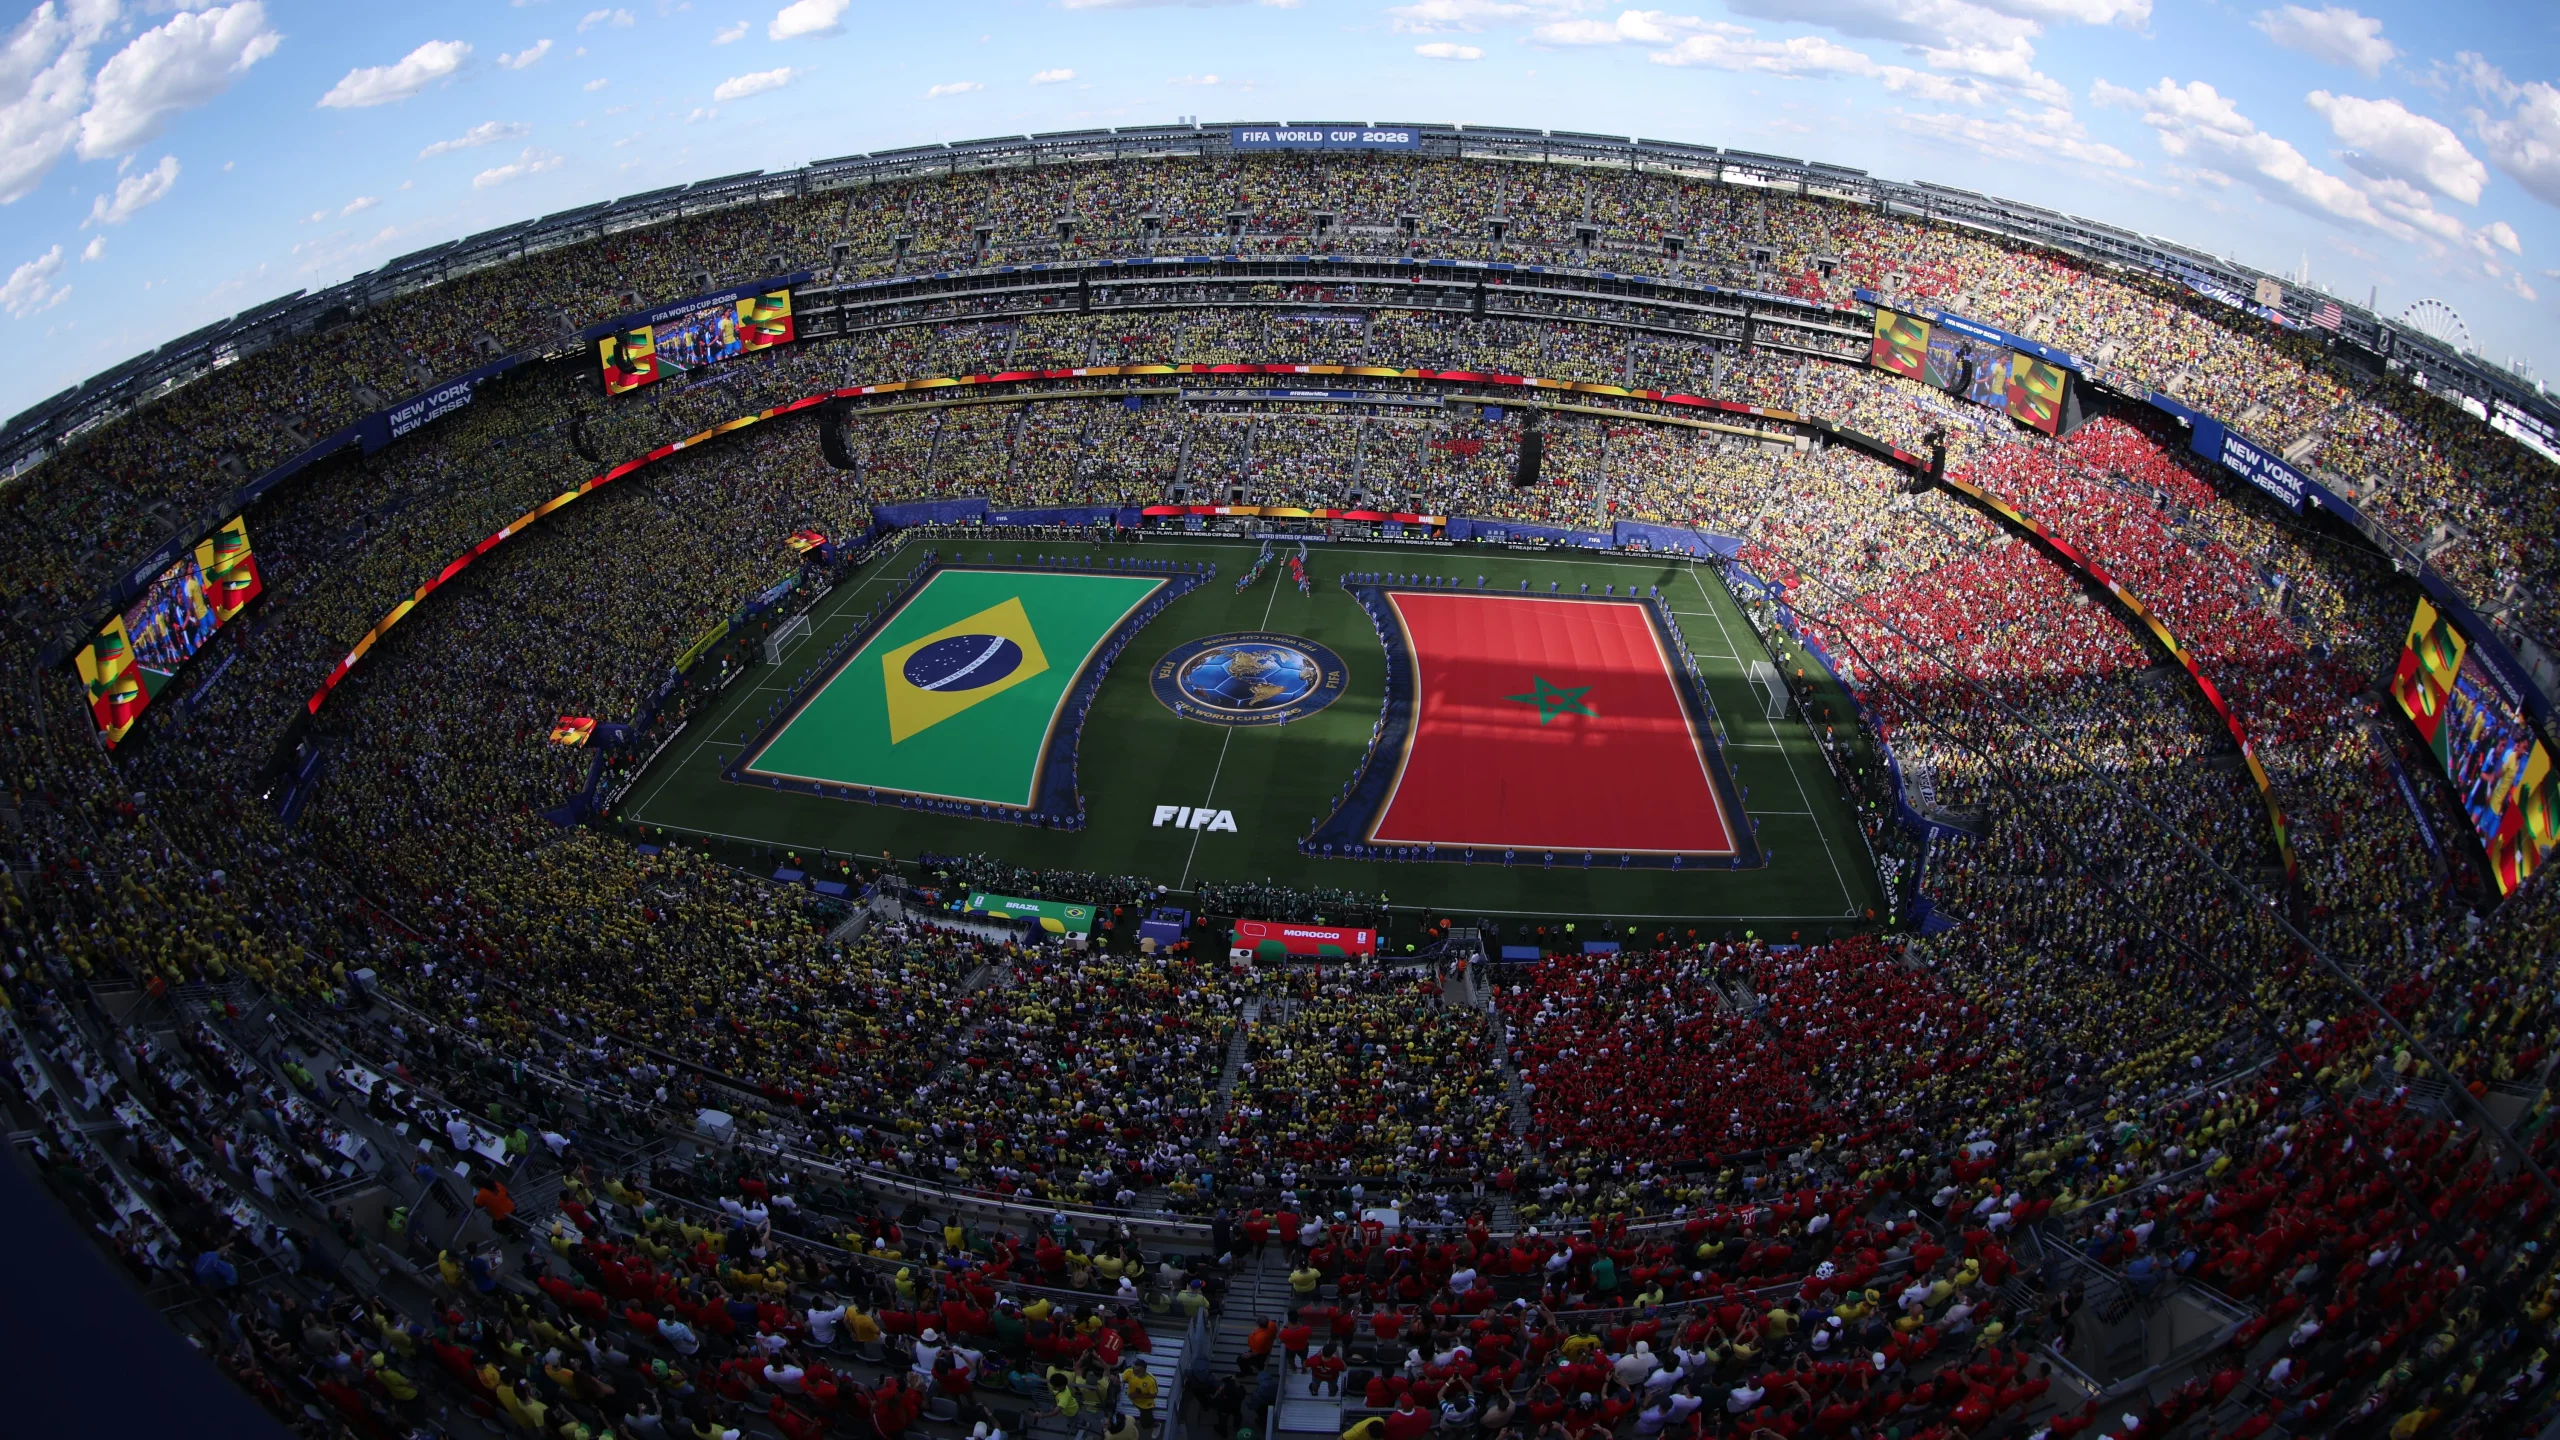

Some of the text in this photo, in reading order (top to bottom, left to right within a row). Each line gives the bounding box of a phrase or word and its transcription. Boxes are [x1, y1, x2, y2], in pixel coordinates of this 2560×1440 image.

[1242, 131, 1409, 143] FIFA WORLD CUP 2026
[652, 293, 738, 322] FIFA WORLD CUP 2026
[1945, 318, 1956, 326] FIFA
[1956, 321, 1973, 331] WORLD
[390, 381, 471, 426] NEW YORK
[393, 394, 472, 438] NEW JERSEY
[2225, 437, 2304, 495] NEW YORK
[2222, 452, 2300, 507] NEW JERSEY
[1262, 636, 1297, 644] WORLD
[1158, 661, 1177, 679] FIFA
[1326, 670, 1340, 689] FIFA
[1195, 709, 1234, 721] WORLD
[614, 782, 632, 804] OFFICIAL
[631, 760, 649, 783] PLAYLIST
[1152, 805, 1237, 832] FIFA
[1006, 901, 1040, 911] BRAZIL
[1283, 929, 1340, 939] MOROCCO
